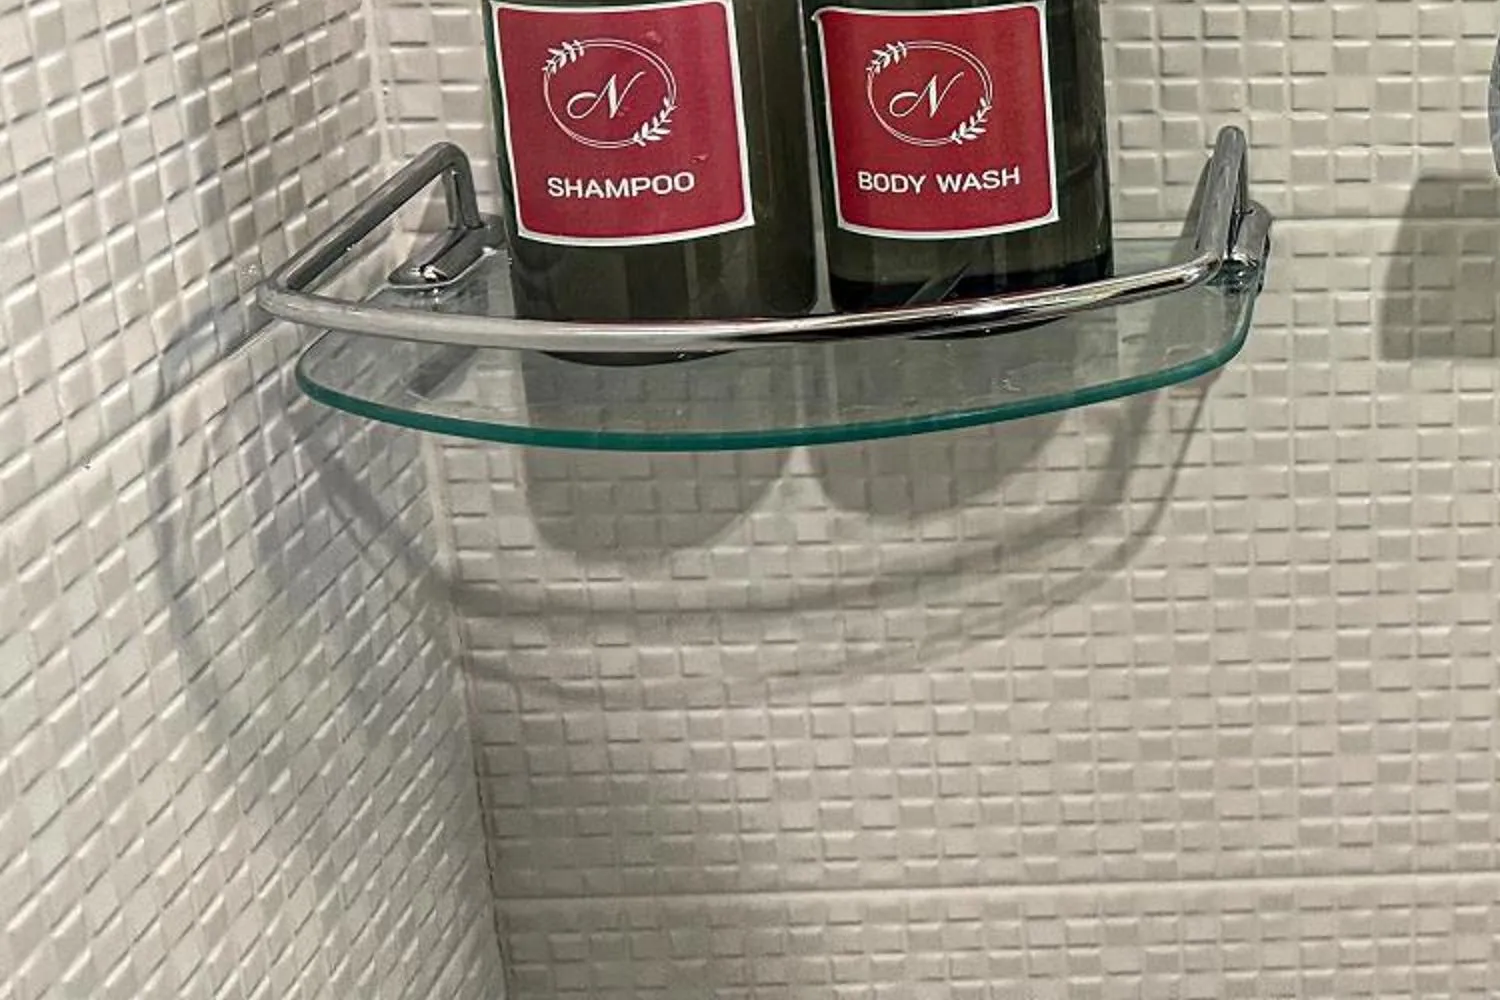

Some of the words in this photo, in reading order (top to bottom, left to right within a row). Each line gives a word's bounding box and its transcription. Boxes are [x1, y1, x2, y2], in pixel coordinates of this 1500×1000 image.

[548, 171, 695, 199] SHAMPOO
[857, 171, 926, 193] BODY
[936, 166, 1020, 193] WASH
